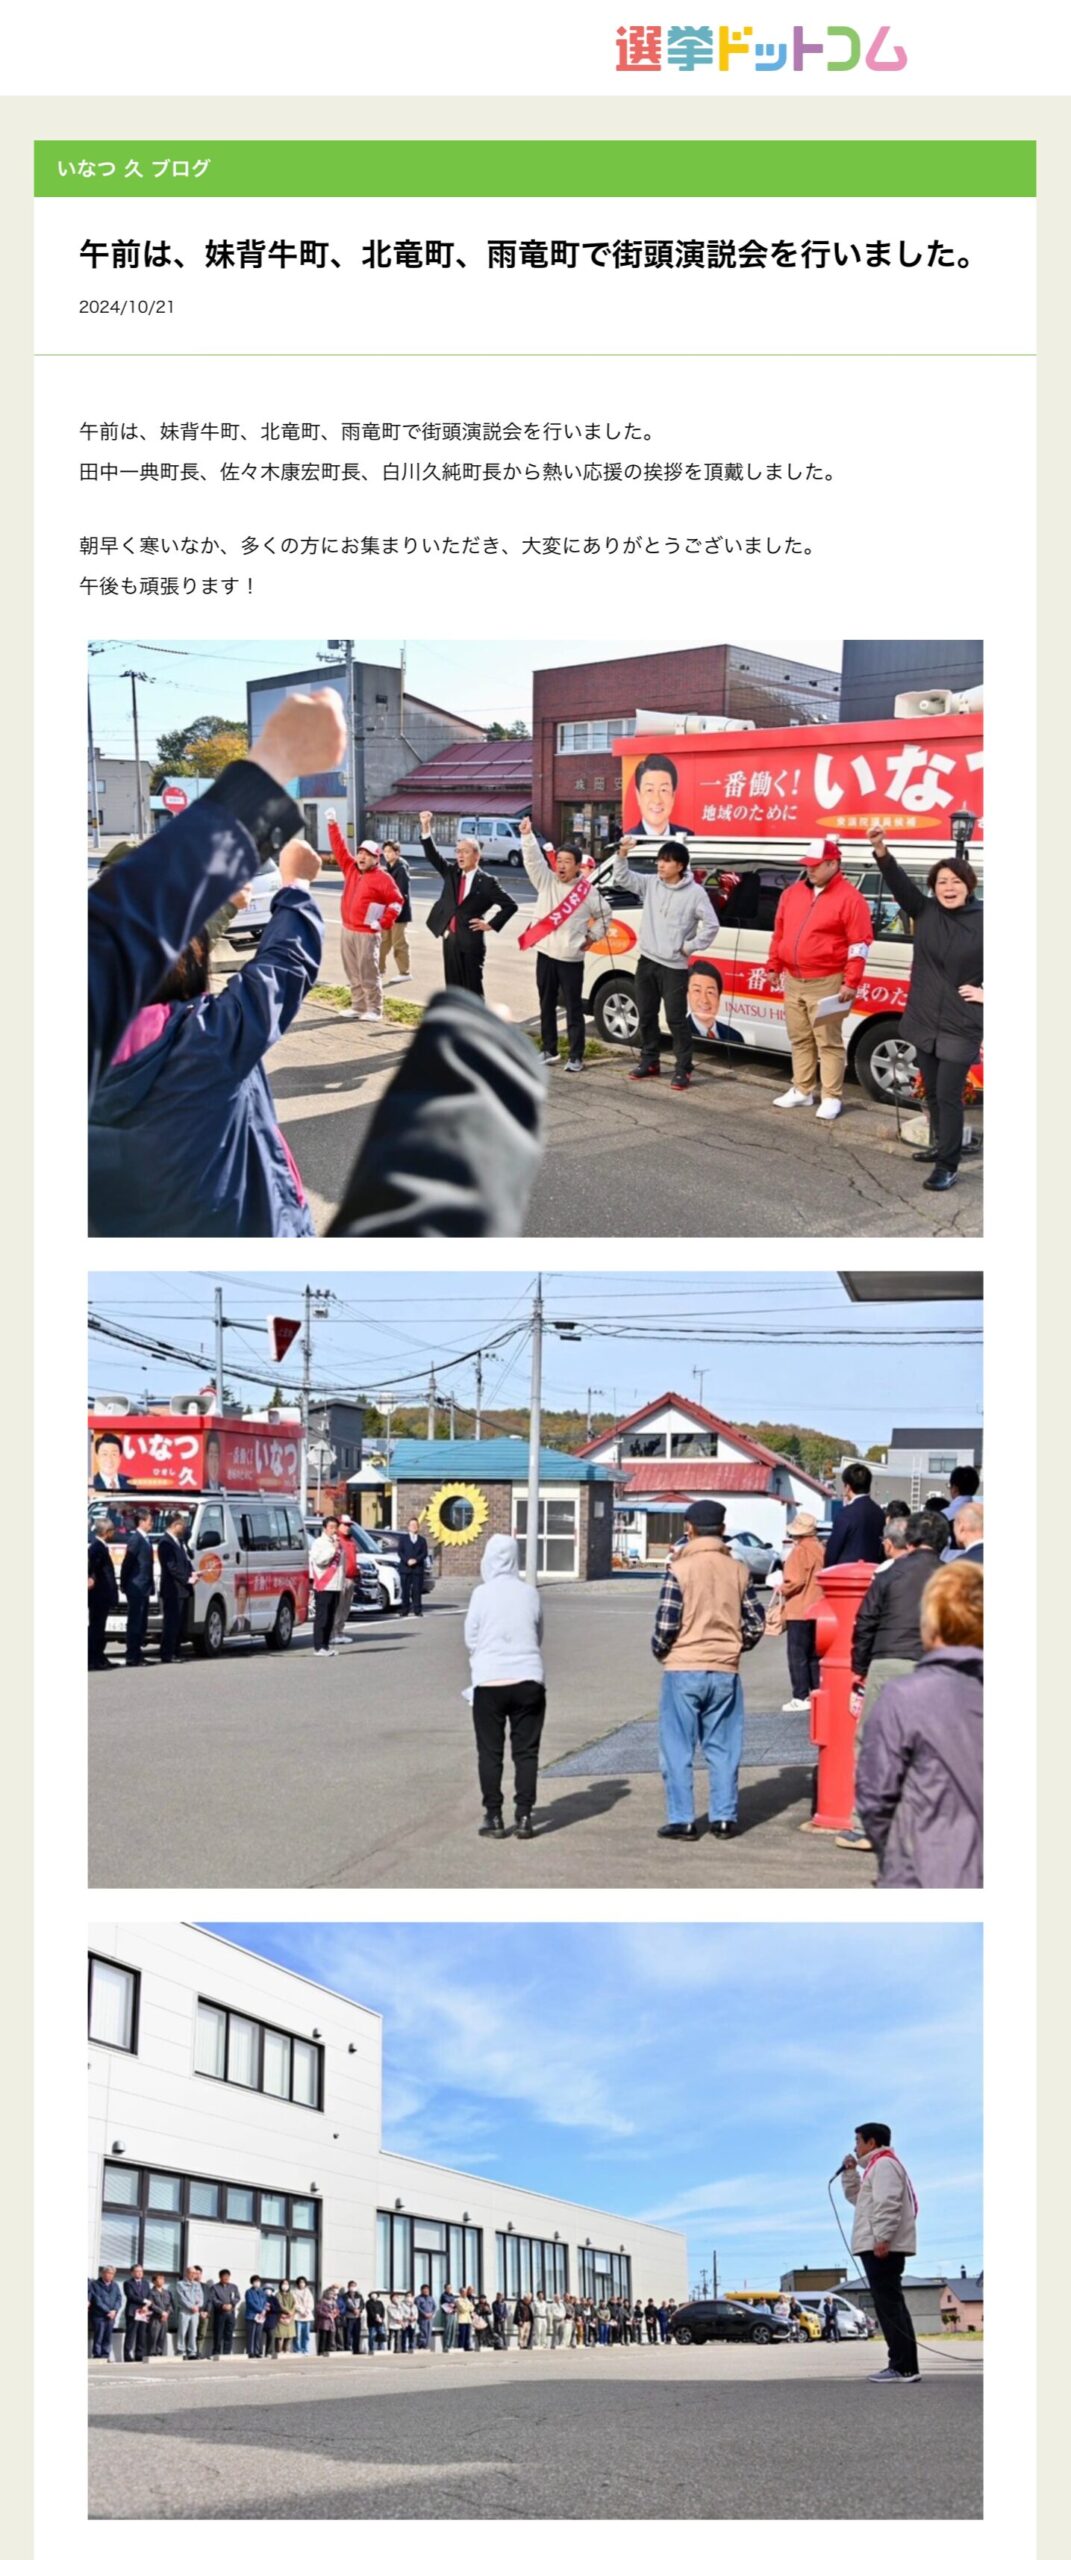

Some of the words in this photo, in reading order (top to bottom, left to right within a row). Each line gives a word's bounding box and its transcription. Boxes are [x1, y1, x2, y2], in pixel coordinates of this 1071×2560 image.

[616, 25, 908, 72] 選挙ドットコム
[59, 160, 116, 177] いなつ
[125, 160, 144, 177] 久
[153, 159, 210, 177] ブログ
[80, 239, 970, 269] 午前は、妹背牛町、北竜町、雨竜町で街頭演説会を行いました。
[80, 300, 174, 315] 2024/10/21
[80, 421, 652, 441] 午前は、妹背牛町、北竜町、雨竜町で街頭演説会を行いました。
[80, 462, 833, 481] 田中一典町長、佐々木康宏町長、白川久純町長から熱い応援の挨拶を頂戴しました。
[80, 536, 812, 555] 朝早く寒いなか、多くの方にお集まりいただき、大変にありがとうございました。
[80, 577, 253, 596] 午後も頑張ります！
[702, 804, 798, 822] 地域のために
[725, 1001, 767, 1018] INATSU
[122, 1433, 199, 1462] いなつ
[255, 1439, 297, 1477] いなつ
[178, 1466, 198, 1486] 久
